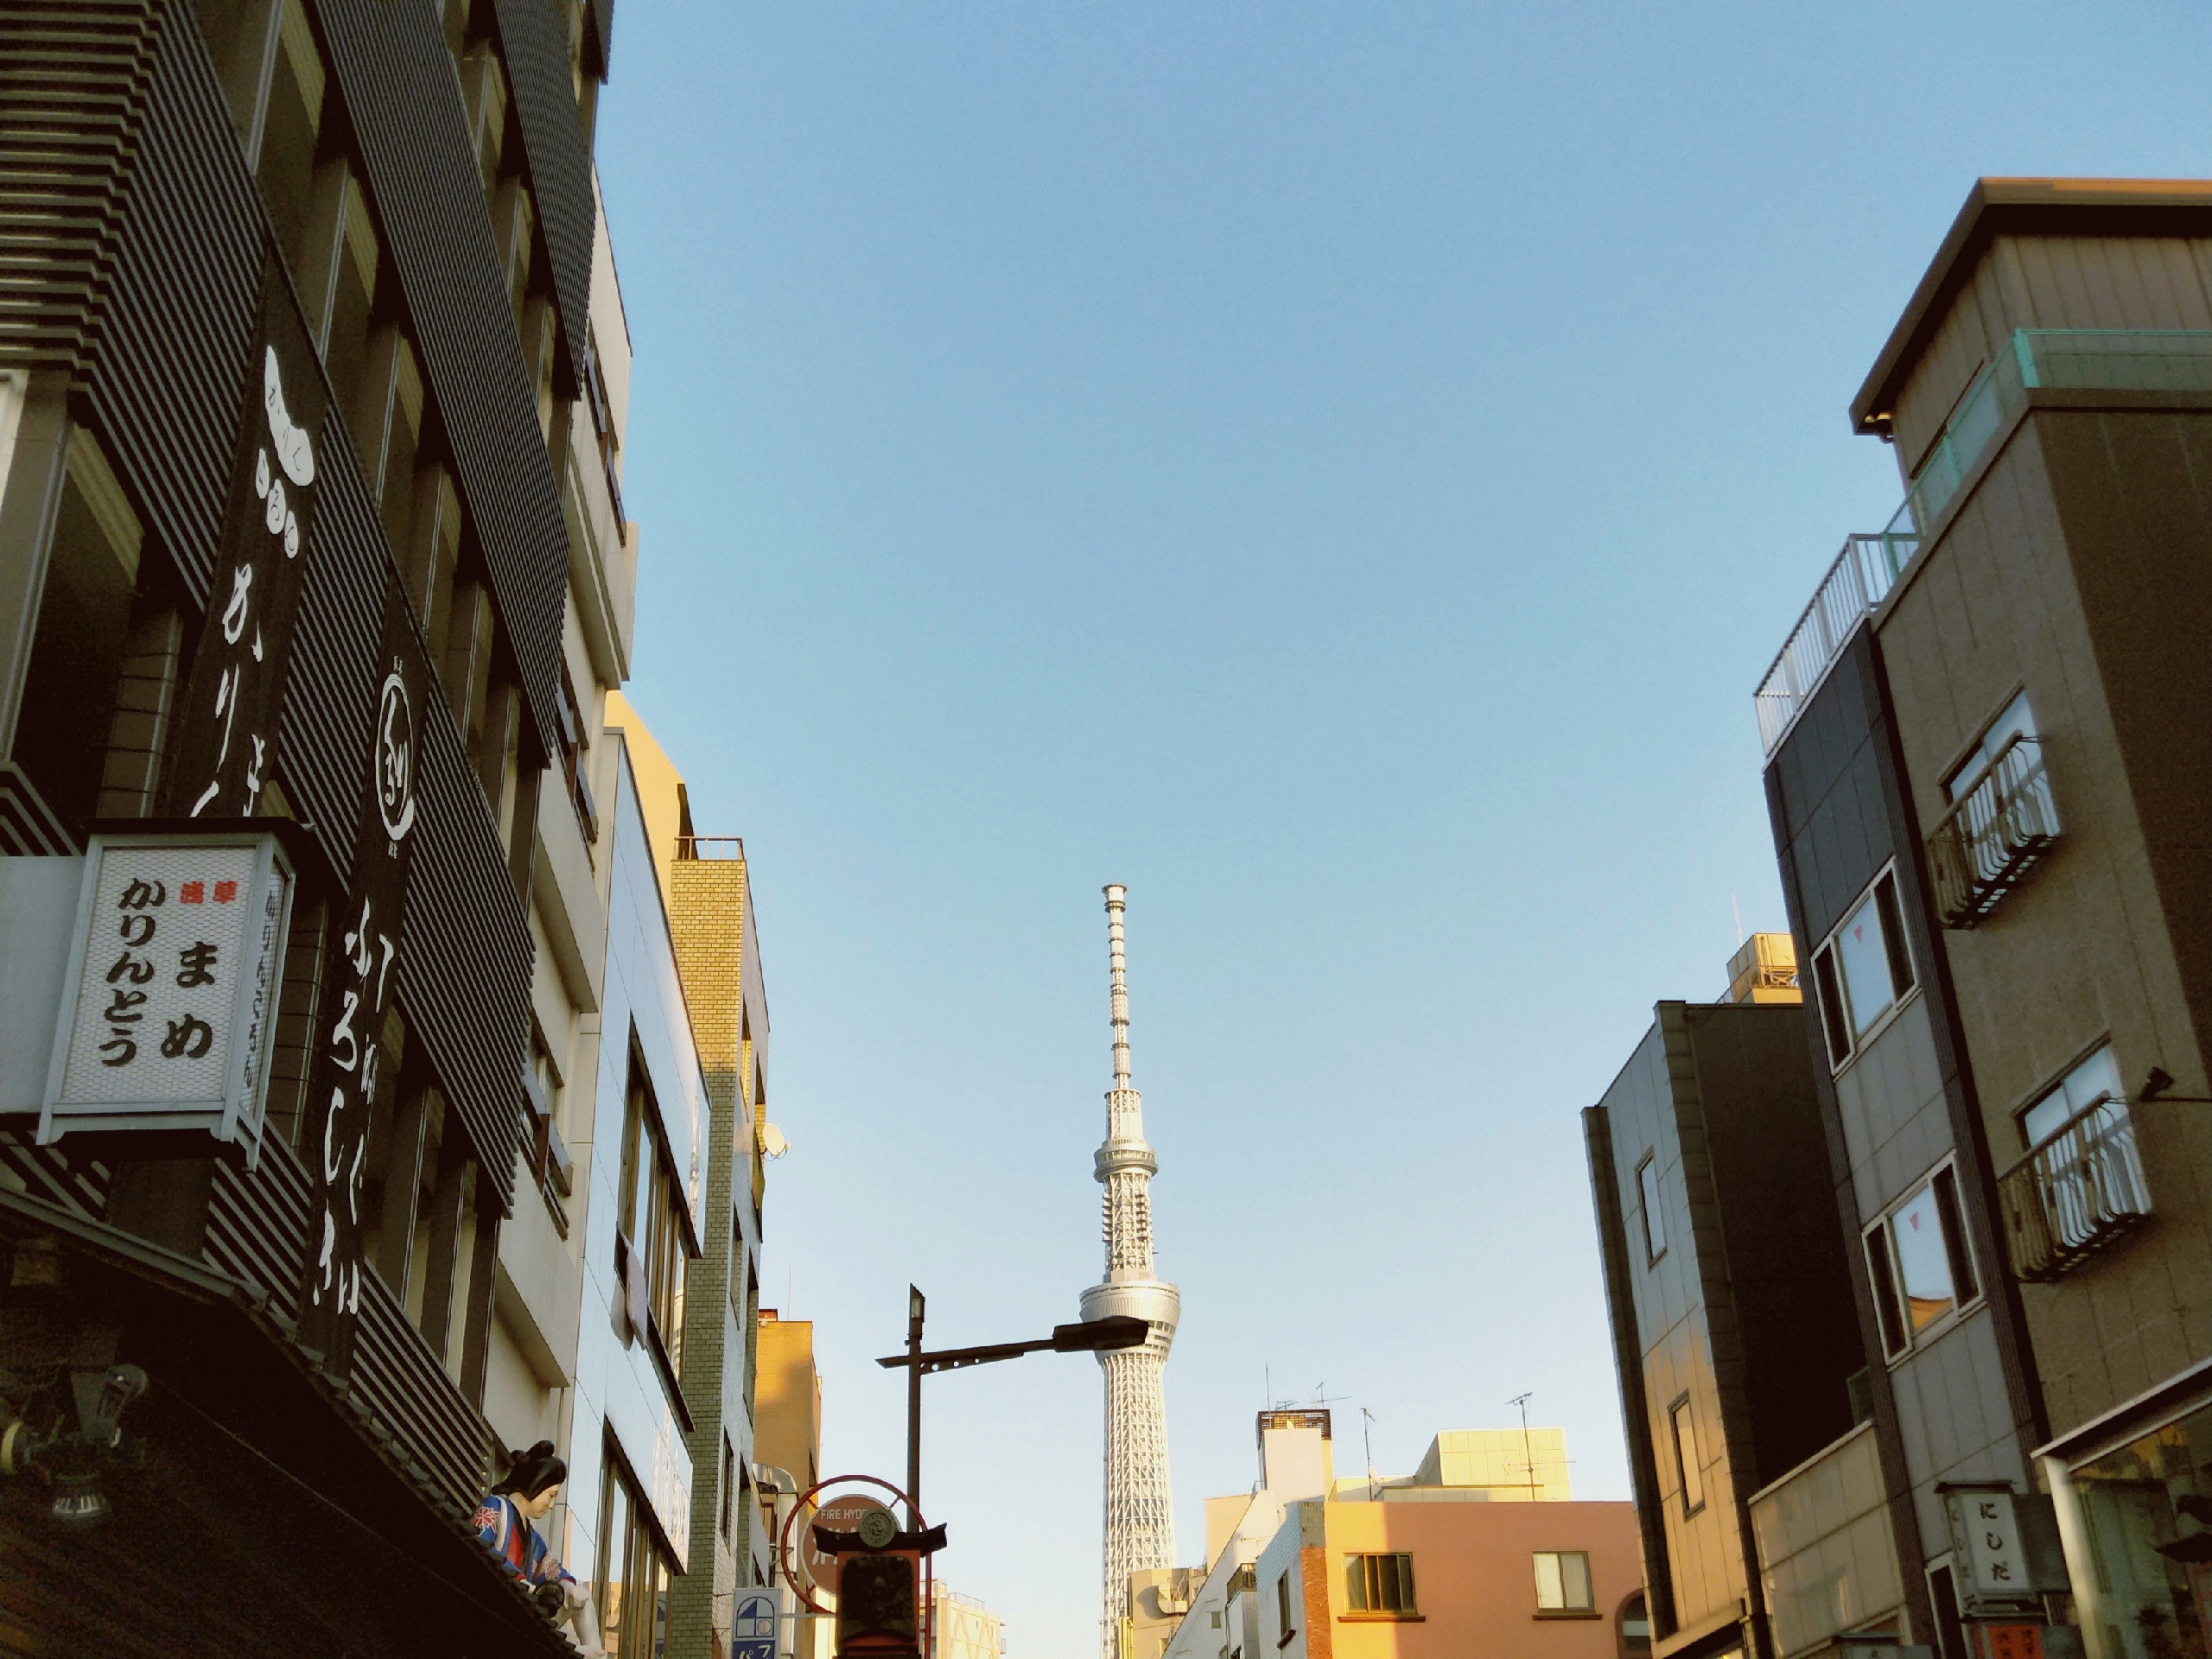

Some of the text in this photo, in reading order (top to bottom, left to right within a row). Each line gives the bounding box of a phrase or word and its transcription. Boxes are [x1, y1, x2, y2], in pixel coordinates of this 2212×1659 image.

[99, 877, 166, 1067] かりんとう
[160, 941, 218, 1058] まめ
[820, 1509, 842, 1520] FIRE
[1979, 1502, 2012, 1581] にしだ
